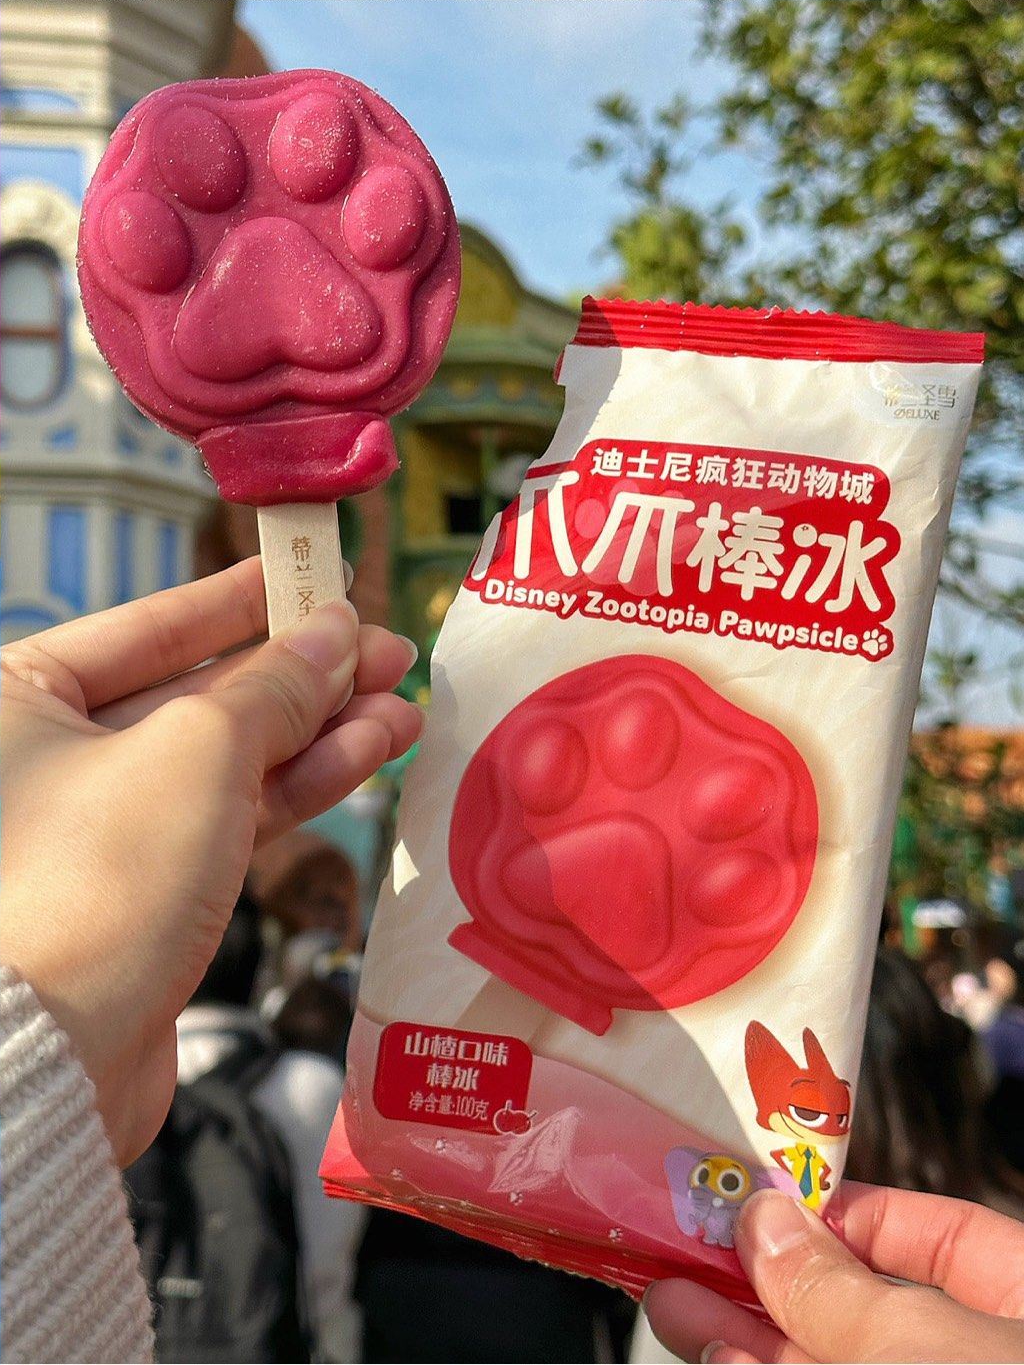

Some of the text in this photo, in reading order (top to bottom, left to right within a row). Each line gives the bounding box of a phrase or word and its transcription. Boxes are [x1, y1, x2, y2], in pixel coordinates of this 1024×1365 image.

[589, 446, 876, 505] 迪士尼疯狂动物城
[472, 470, 888, 614] 爪爪棒冰
[484, 577, 859, 651] Disney Zootopia Pawpsicle
[404, 1031, 508, 1066] 山楂口味
[426, 1062, 480, 1091] 棒冰
[408, 1090, 490, 1121] 净含量:100克
